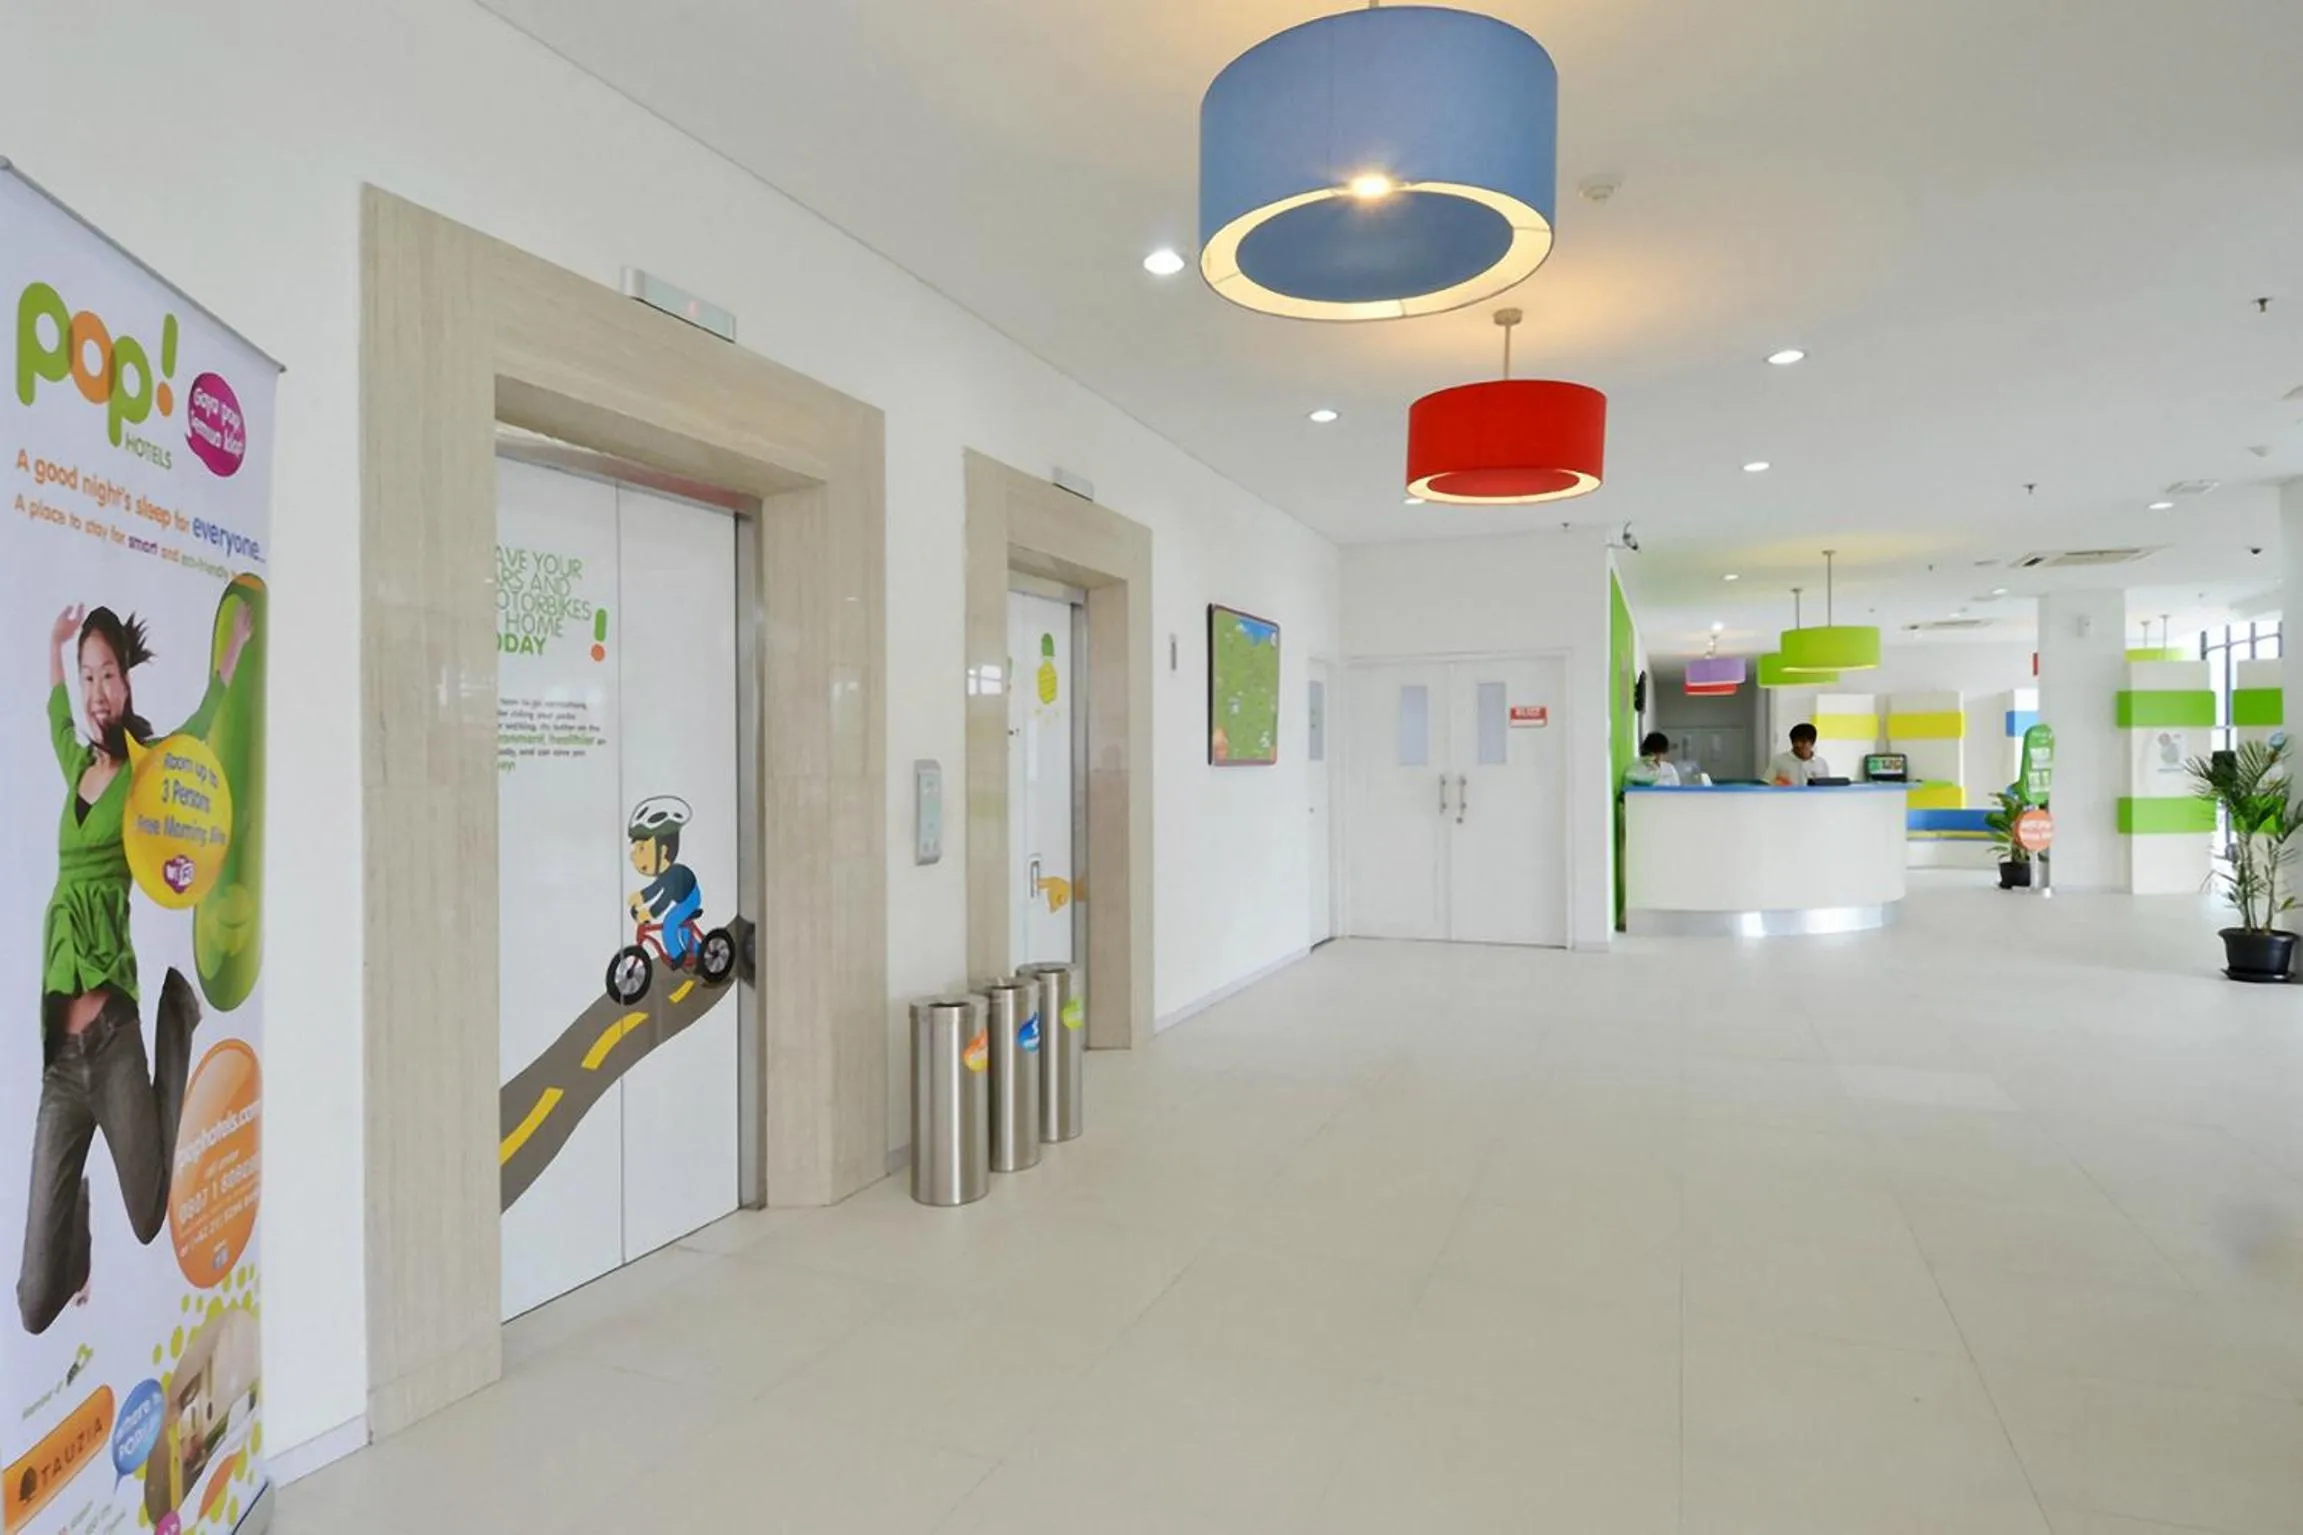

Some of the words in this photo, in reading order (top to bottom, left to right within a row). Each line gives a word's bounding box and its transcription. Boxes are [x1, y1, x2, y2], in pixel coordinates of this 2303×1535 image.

[16, 281, 178, 448] pop!
[125, 431, 172, 470] HOTELS
[16, 448, 29, 472] A
[34, 458, 78, 490] good
[83, 473, 131, 511] night's
[136, 495, 171, 531] sleep
[174, 508, 190, 534] for
[14, 493, 26, 512] A
[30, 500, 66, 525] place
[69, 512, 81, 530] to
[128, 535, 158, 556] smart
[498, 567, 524, 590] RS
[530, 572, 571, 597] AND
[532, 551, 583, 579] YOUR
[506, 610, 563, 638] HOME
[41, 1417, 103, 1485] TAUZIA
